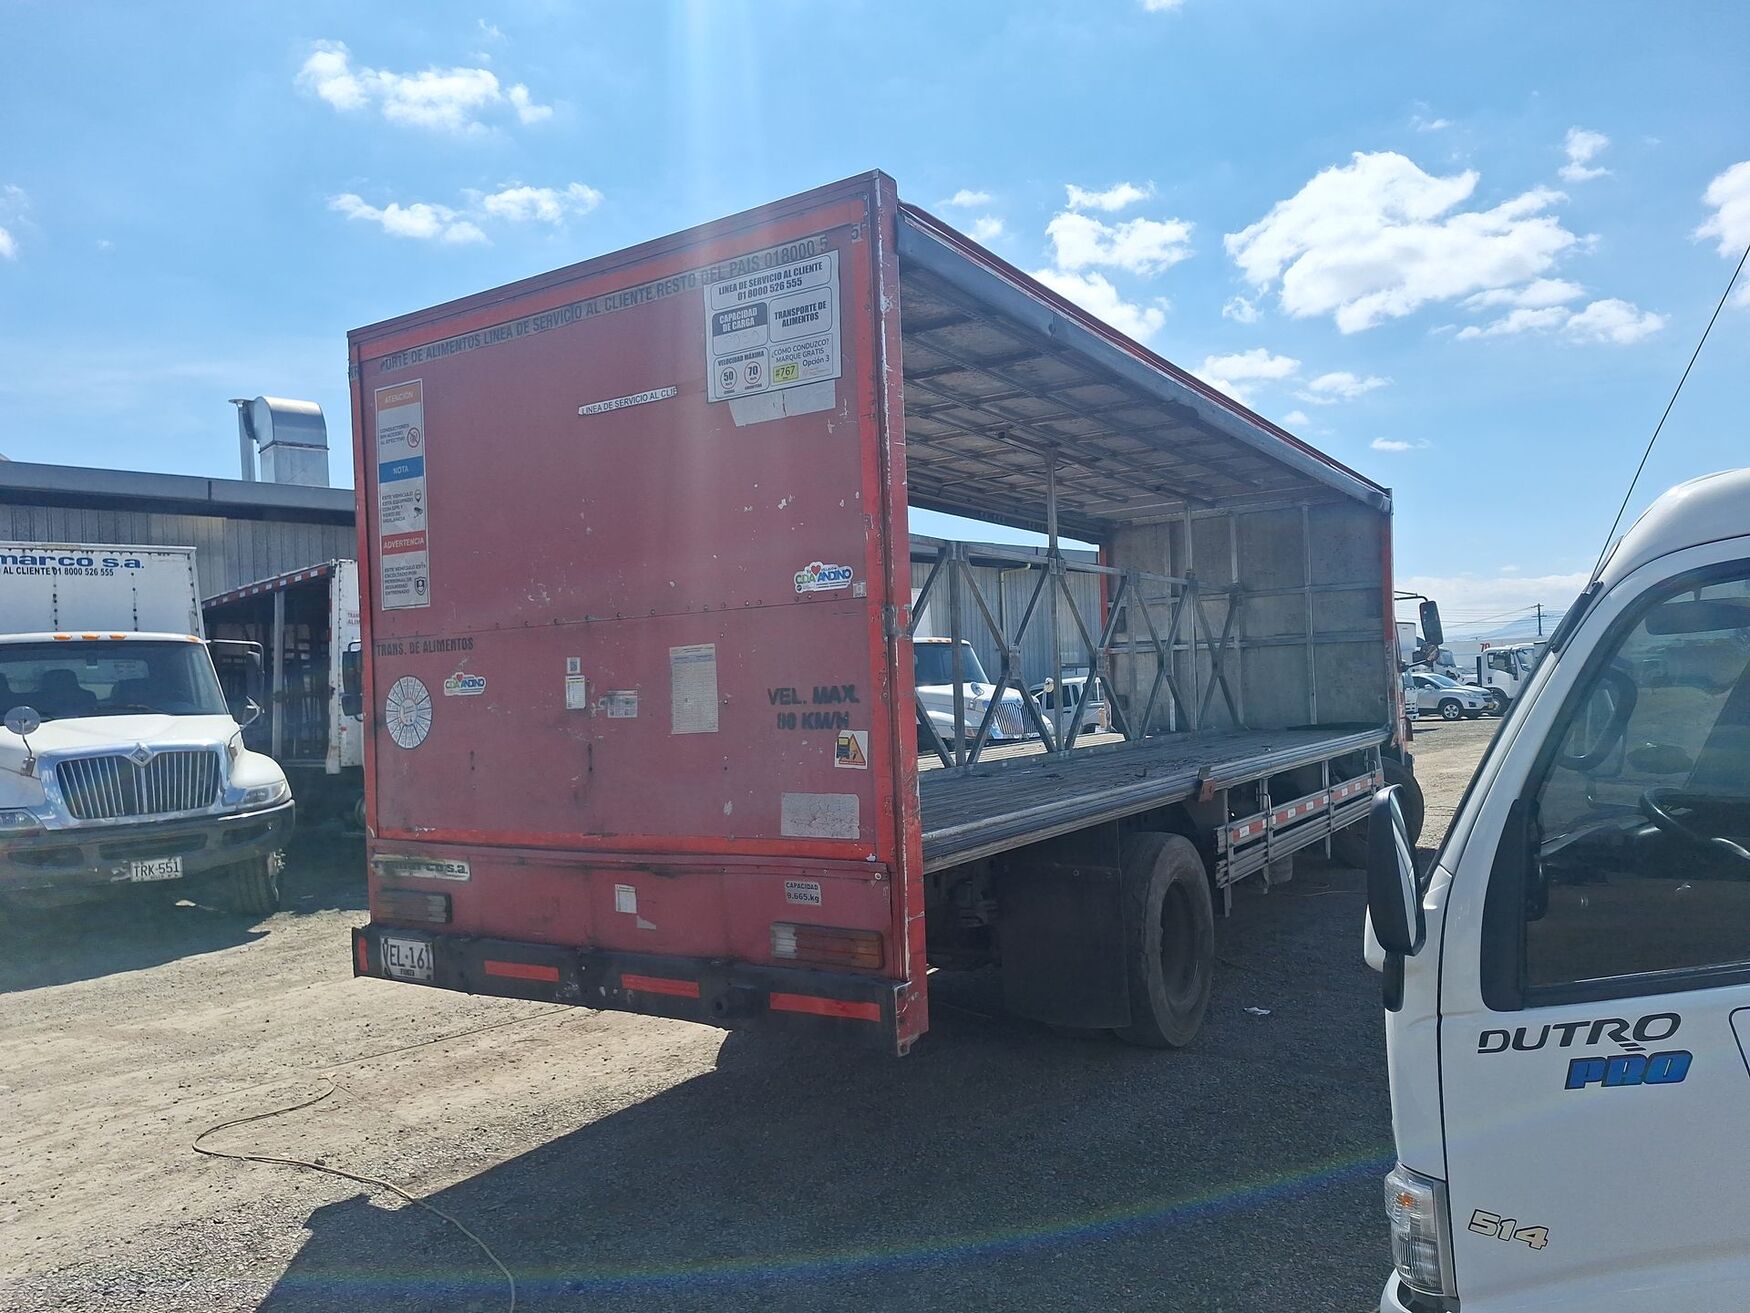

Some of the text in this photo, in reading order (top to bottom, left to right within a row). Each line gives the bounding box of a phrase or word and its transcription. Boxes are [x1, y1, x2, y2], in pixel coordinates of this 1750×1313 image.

[719, 262, 823, 295] LINEA DE SERVICIO AL CLIENTE
[738, 278, 802, 301] 01 8000 526 555
[411, 349, 422, 363] DE
[426, 335, 481, 359] ALIMENTOS
[484, 326, 513, 345] LINEA
[516, 321, 529, 336] DE
[533, 305, 582, 332] SERVICIO
[586, 304, 600, 318] AL
[604, 287, 652, 311] CLIENTE
[656, 273, 696, 297] RESTO
[703, 265, 724, 285] DEL
[729, 255, 761, 277] PAIS
[764, 239, 815, 268] 018000
[720, 307, 758, 324] CAPACIDAD
[774, 301, 826, 320] TRANSPORTE DE
[722, 317, 755, 332] DE CARGA
[782, 312, 819, 327] ALIMENTOS
[793, 338, 829, 352] CONDUZCO?
[776, 347, 824, 363] MARQUE GRATIS
[723, 371, 734, 381] 50
[748, 365, 758, 377] 70
[582, 405, 602, 415] LINEA
[603, 402, 614, 410] DE
[615, 393, 648, 407] SERVICIO
[649, 392, 659, 400] AL
[393, 465, 409, 475] NOTA
[383, 537, 425, 549] ADVERTENCIA
[102, 556, 145, 569] s.a.
[3, 567, 14, 575] AL
[16, 567, 50, 576] CLIENTE
[64, 568, 82, 576] 8000
[85, 568, 99, 576] 526
[100, 568, 114, 577] 555
[817, 568, 852, 582] ANDINO
[376, 637, 474, 657] TRANS. DE ALIMENTOS
[768, 684, 860, 705] VEL. MAX.
[786, 882, 819, 891] CAPACIDAD
[1477, 1012, 1682, 1053] DUTRO
[1564, 1050, 1694, 1090] PRO
[1468, 1209, 1549, 1250] 514
